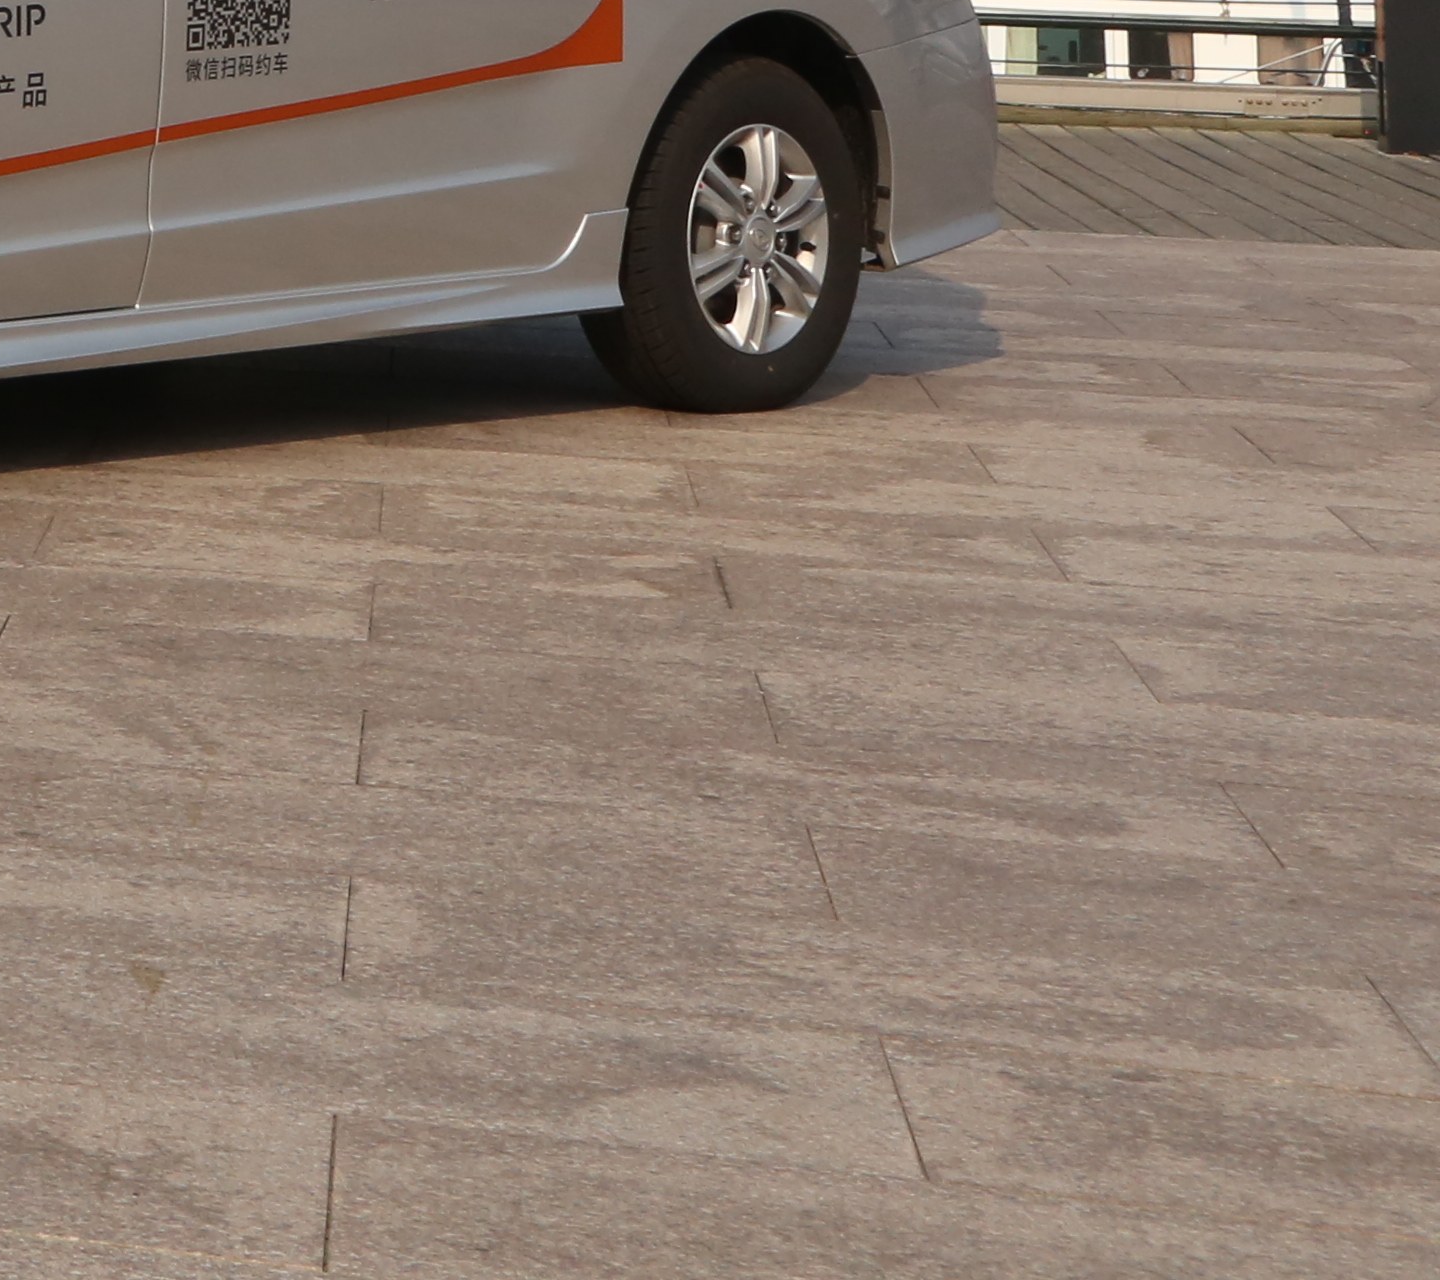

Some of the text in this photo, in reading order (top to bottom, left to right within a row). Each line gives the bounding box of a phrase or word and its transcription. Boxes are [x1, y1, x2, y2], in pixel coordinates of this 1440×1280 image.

[185, 52, 289, 83] 微信扫码约车
